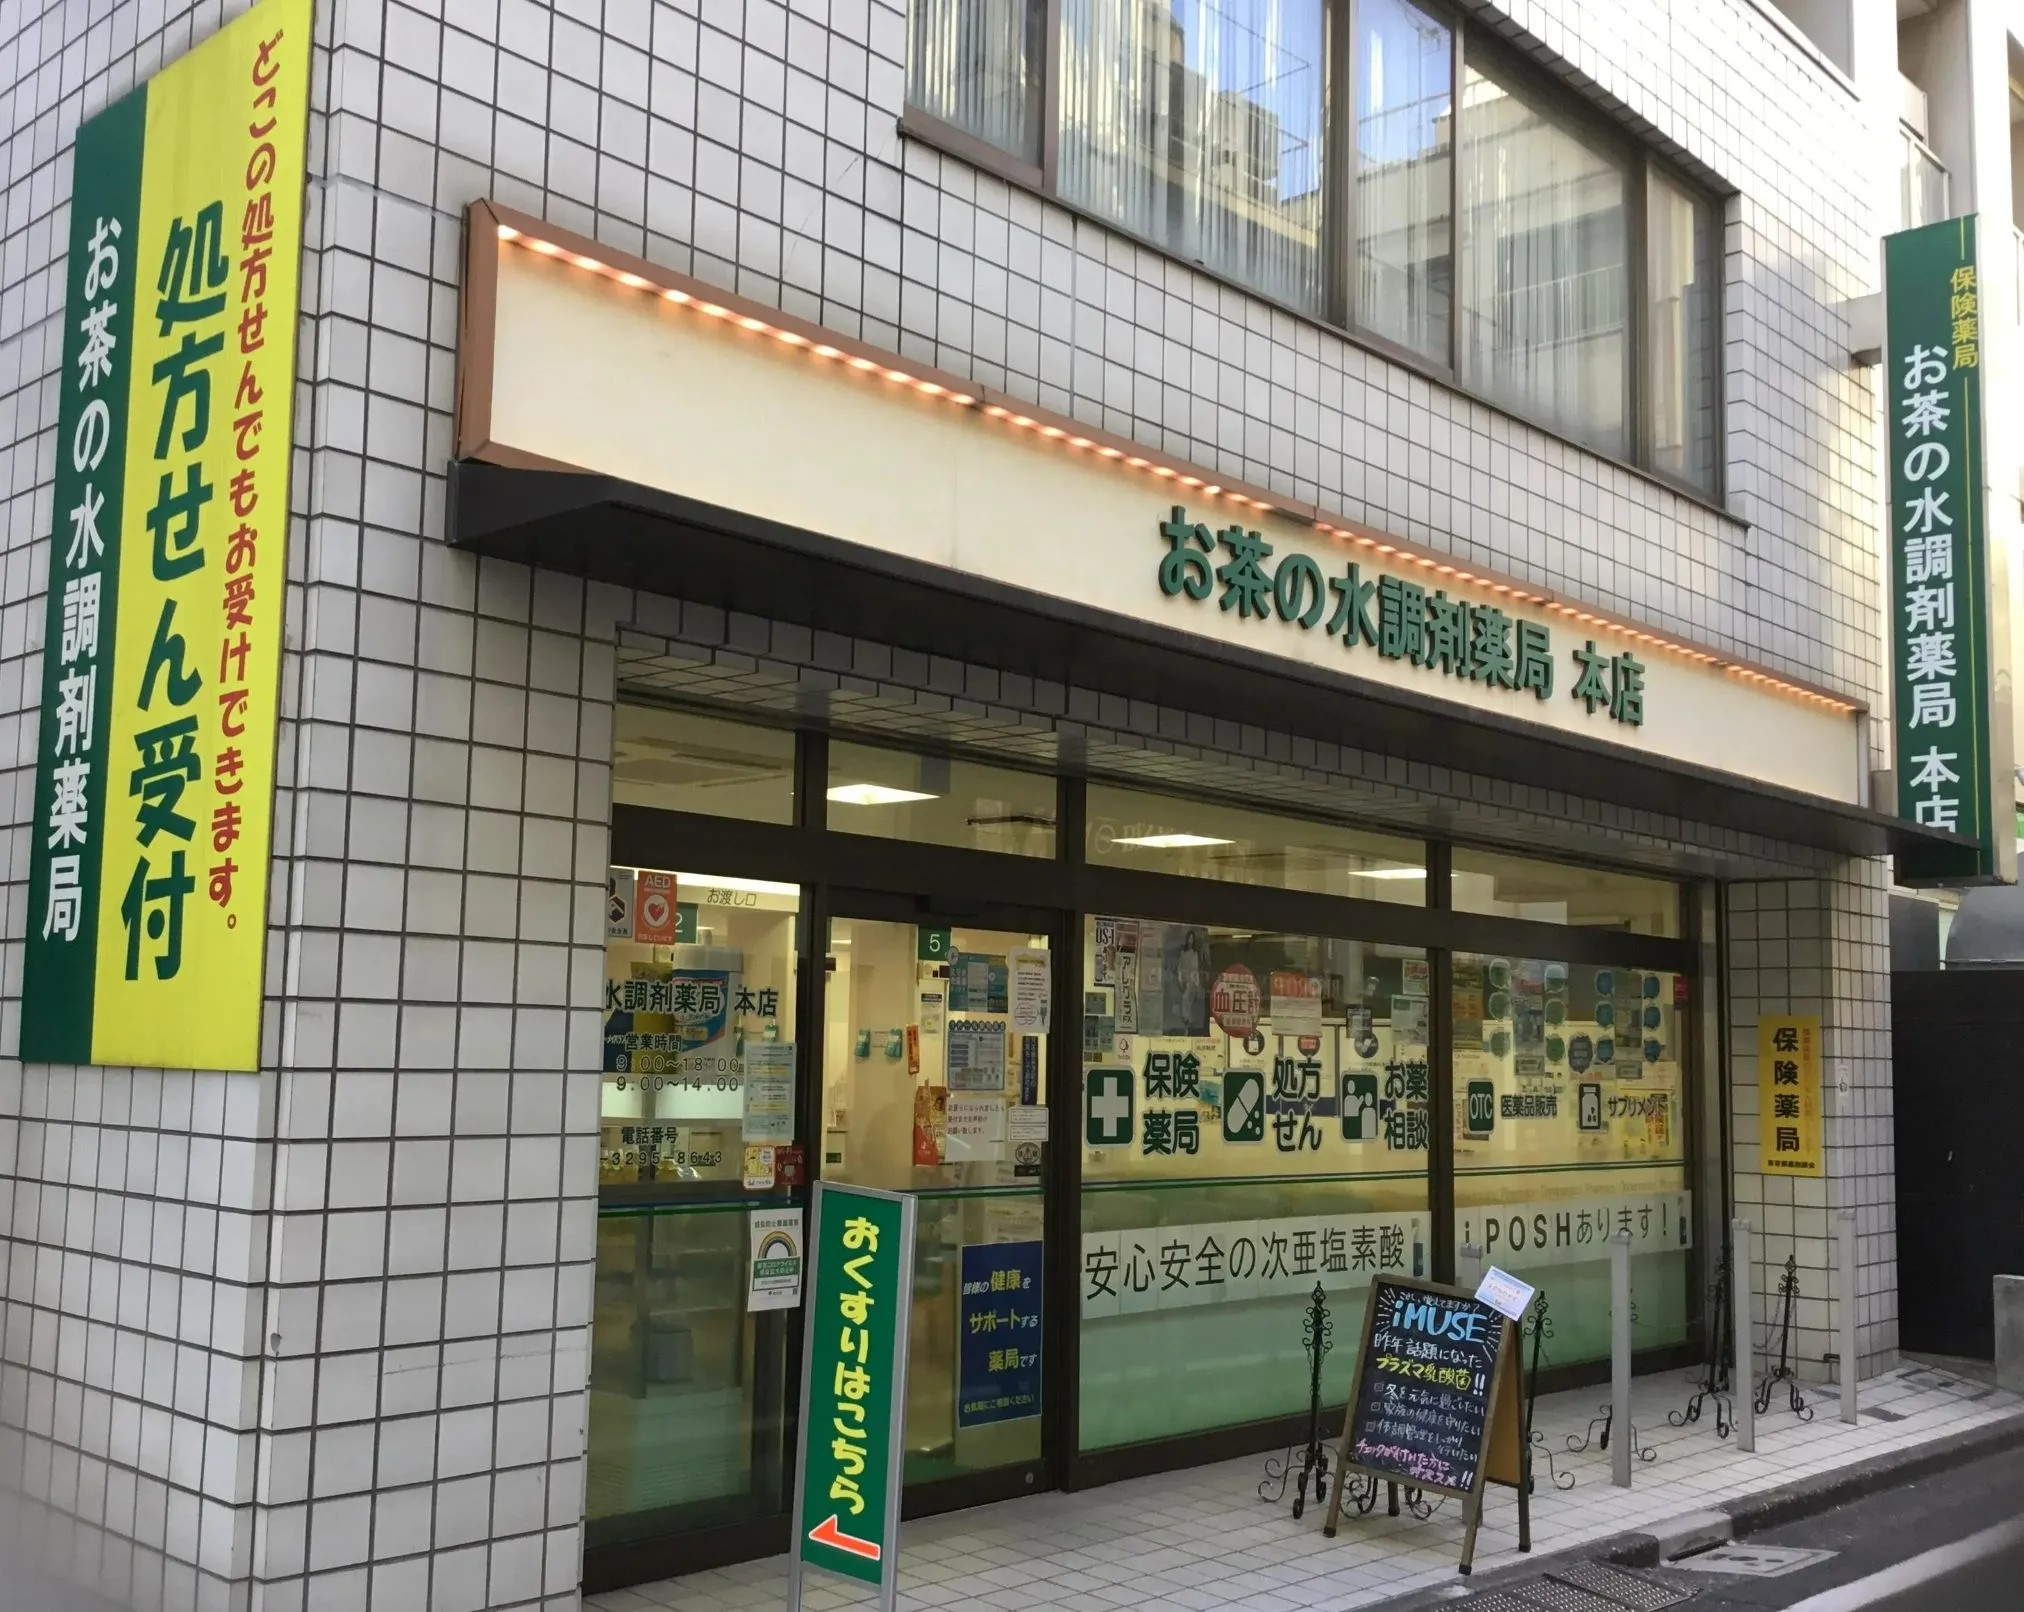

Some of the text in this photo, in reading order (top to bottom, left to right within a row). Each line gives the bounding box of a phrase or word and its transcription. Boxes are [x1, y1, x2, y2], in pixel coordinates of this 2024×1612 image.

[1950, 265, 1978, 370] 保険薬局
[208, 28, 284, 930] どこの処方せんでもお受けできます。
[1902, 344, 1957, 729] お茶の水調剤薬局
[42, 216, 122, 942] お茶の水調剤薬局
[120, 200, 229, 981] 処方せん受付
[1158, 505, 1645, 726] お茶の水調剤薬局 本店
[644, 875, 671, 888] AED
[706, 888, 757, 906] お渡し口
[929, 933, 941, 953] 5
[734, 986, 779, 1017] 本店
[625, 1032, 682, 1051] 営業時間
[1142, 1053, 1200, 1099] 保険
[1272, 1056, 1322, 1100] 処方
[1384, 1060, 1428, 1100] お薬
[1773, 1027, 1800, 1152] 保険薬局
[1469, 1093, 1493, 1119] OTC
[1501, 1094, 1557, 1117] 医薬品販売
[622, 1126, 678, 1144] 電話番号
[1142, 1110, 1199, 1155] 薬局
[1272, 1112, 1322, 1151] せん
[1384, 1111, 1428, 1150] 相談
[1085, 1224, 1405, 1300] 安心安全の次亜塩素酸
[969, 1308, 1039, 1334] サポートする
[1392, 1300, 1487, 1343] iMUSE
[829, 1216, 880, 1515] おくすりはこちら
[988, 1348, 1037, 1372] 薬局です
